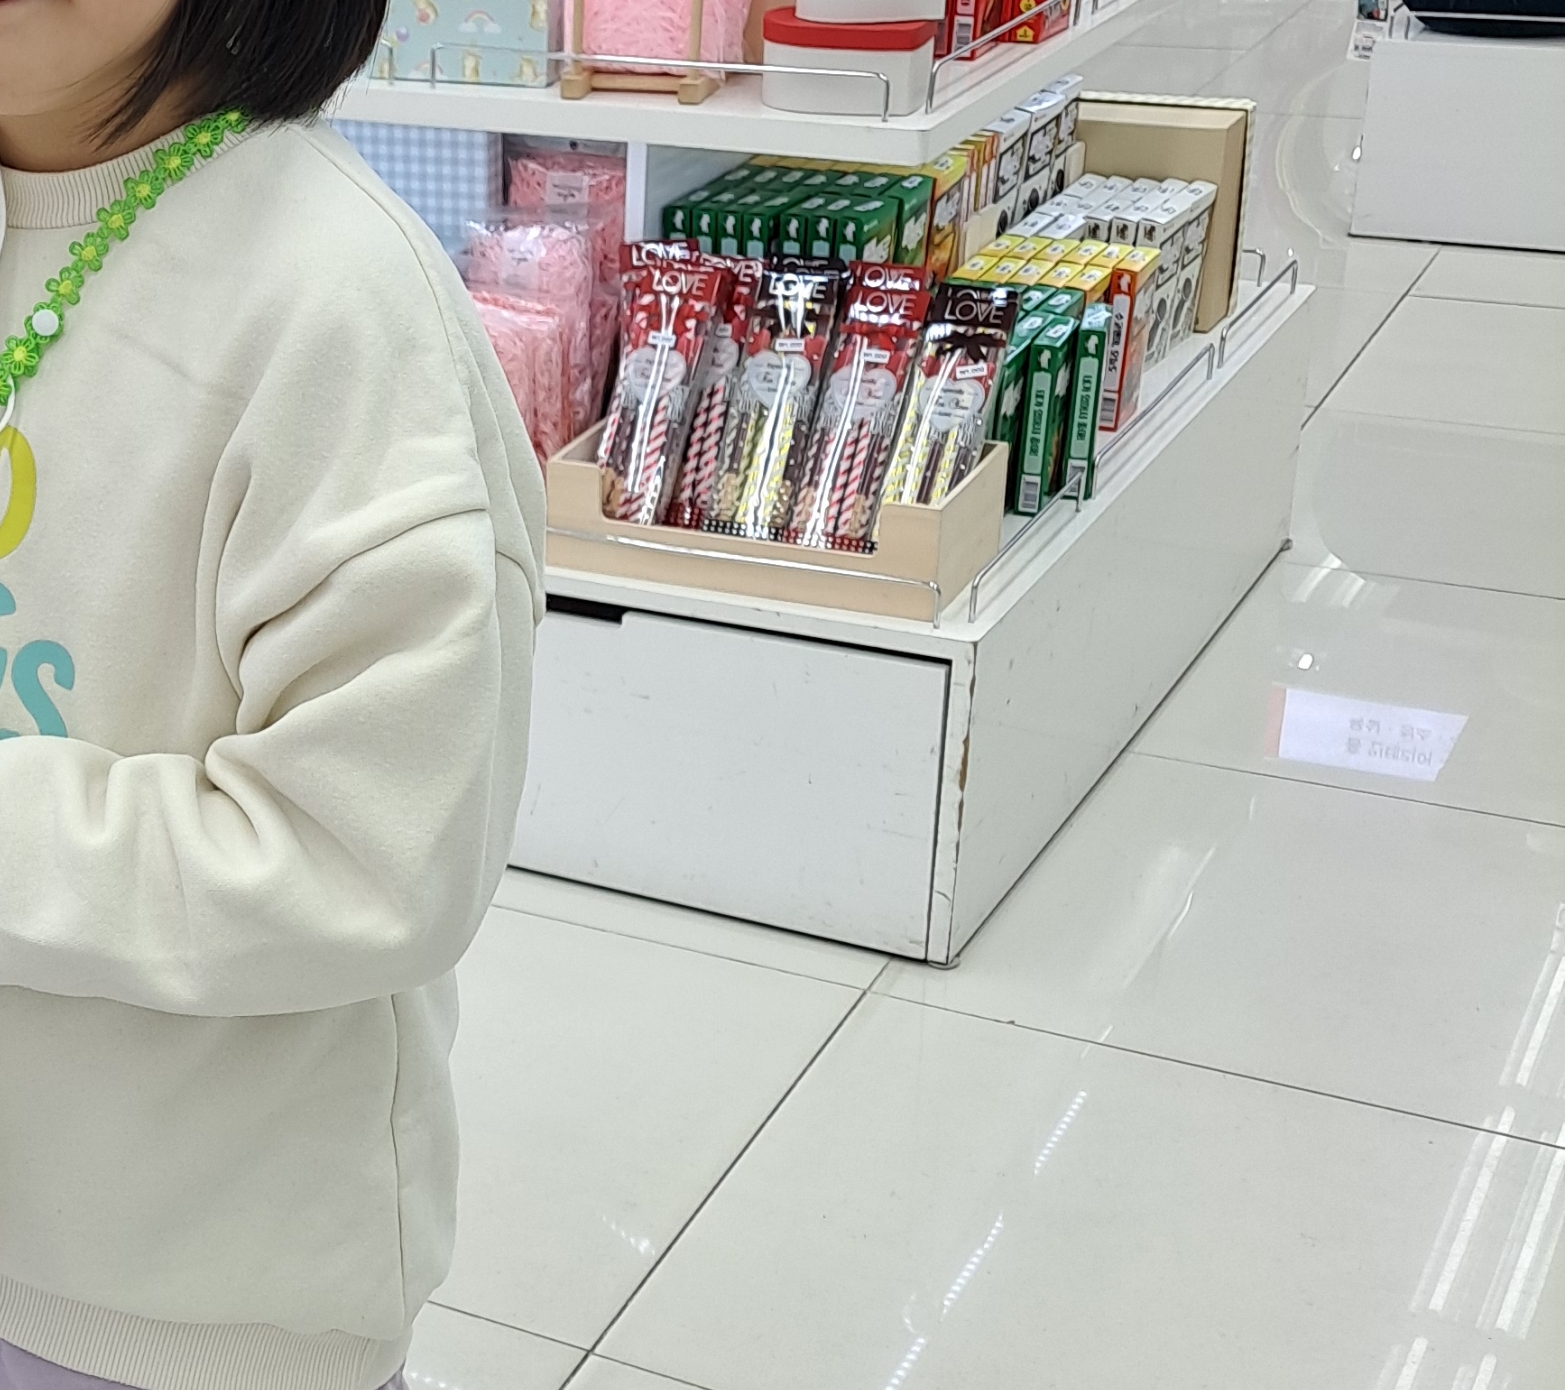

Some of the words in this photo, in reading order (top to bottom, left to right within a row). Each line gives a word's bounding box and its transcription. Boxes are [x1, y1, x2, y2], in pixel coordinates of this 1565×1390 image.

[652, 270, 709, 296] LOVE
[769, 273, 827, 299] LOVE
[856, 291, 917, 315] LOVE
[944, 299, 1004, 324] LOVE
